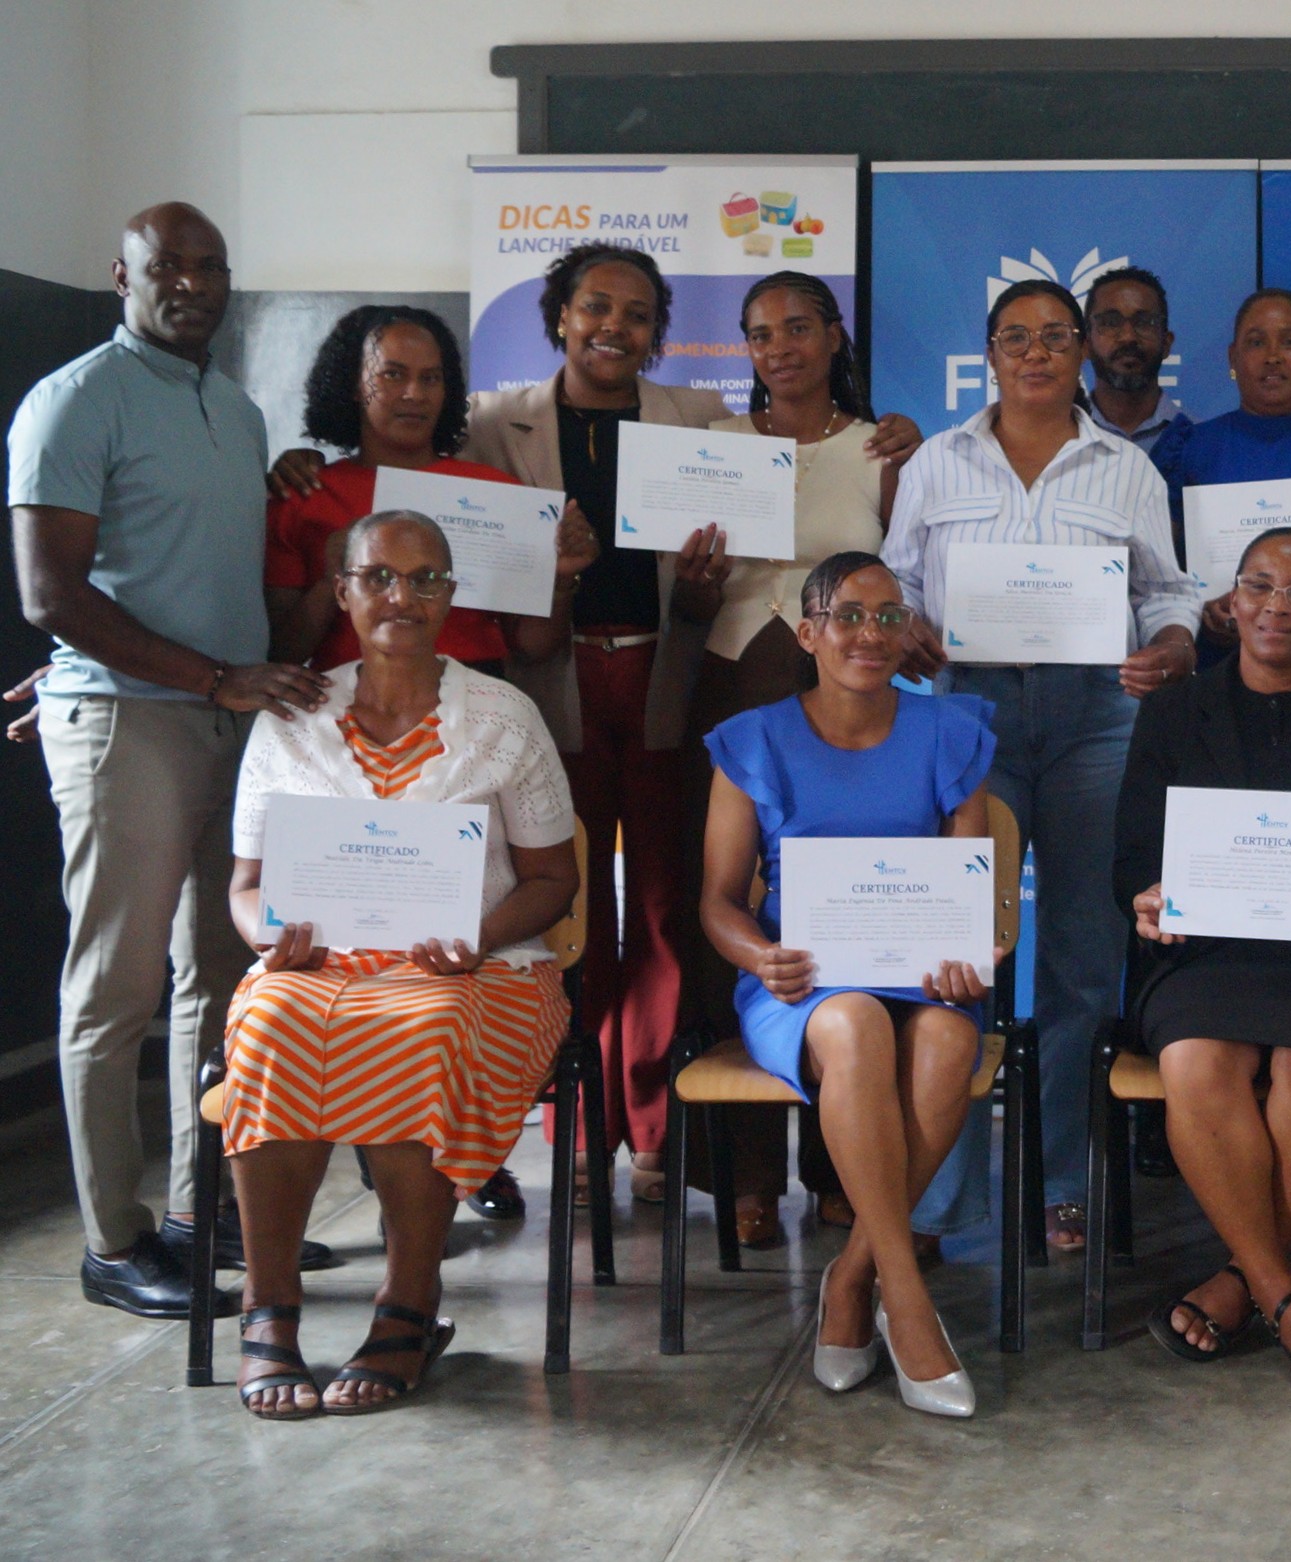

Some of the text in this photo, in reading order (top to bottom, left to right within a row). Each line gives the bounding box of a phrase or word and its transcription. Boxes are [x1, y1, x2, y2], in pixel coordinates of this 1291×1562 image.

[498, 204, 689, 231] DICAS PARA UM
[497, 236, 575, 253] LANCHE
[663, 342, 750, 357] OMENDAD
[690, 379, 719, 390] UMA
[678, 466, 743, 479] CERTIFICADO
[435, 514, 505, 530] CERTIFICADO
[1006, 580, 1073, 589] CERTIFICADO
[339, 844, 420, 857] CERTIFICADO
[851, 884, 930, 893] CERTIFICADO
